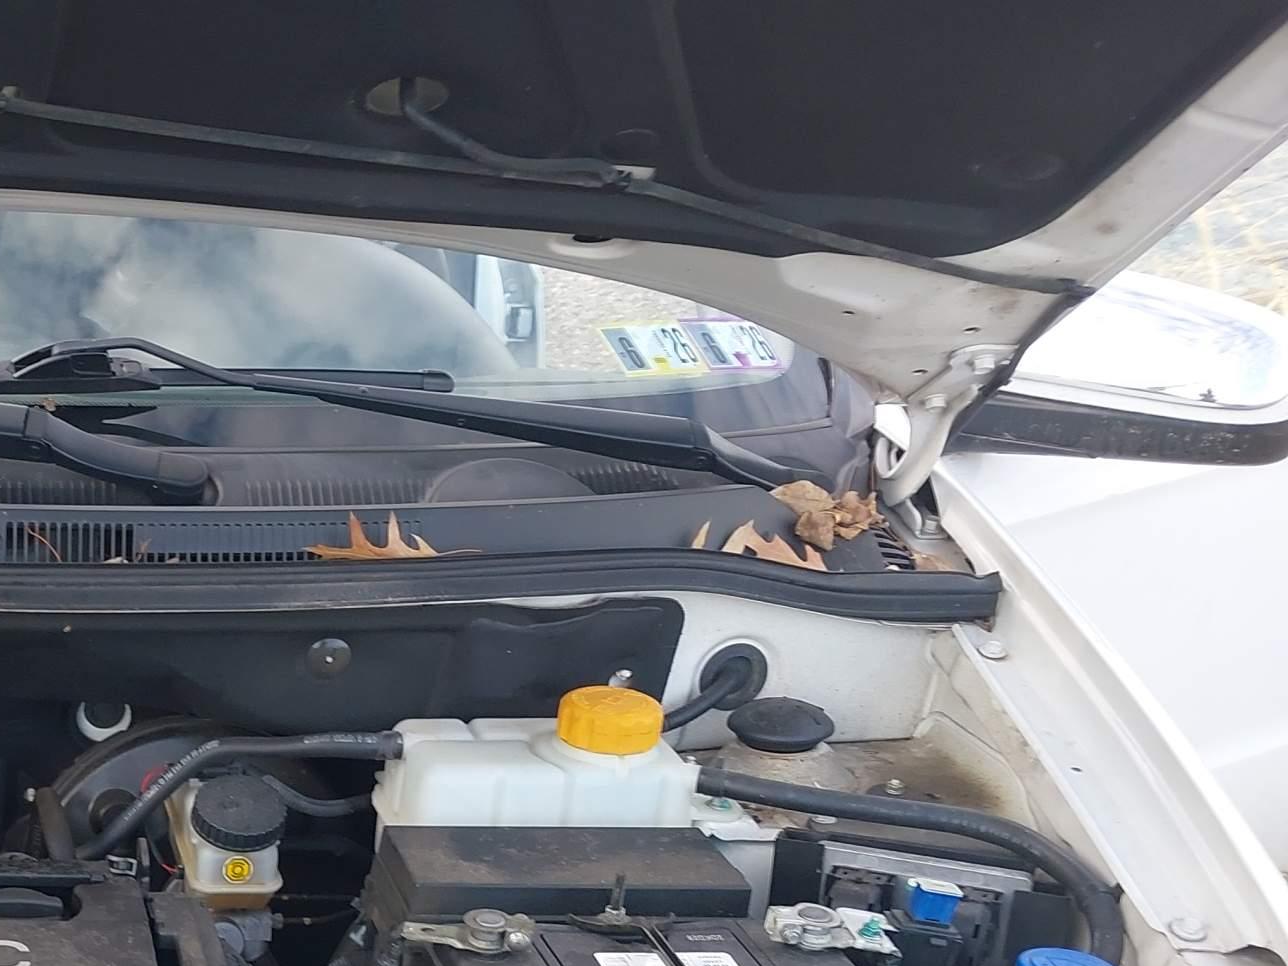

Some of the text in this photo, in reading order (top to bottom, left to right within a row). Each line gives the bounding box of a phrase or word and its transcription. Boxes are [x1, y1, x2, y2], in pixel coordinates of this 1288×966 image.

[619, 327, 698, 369] 6 26
[738, 325, 776, 361] 26
